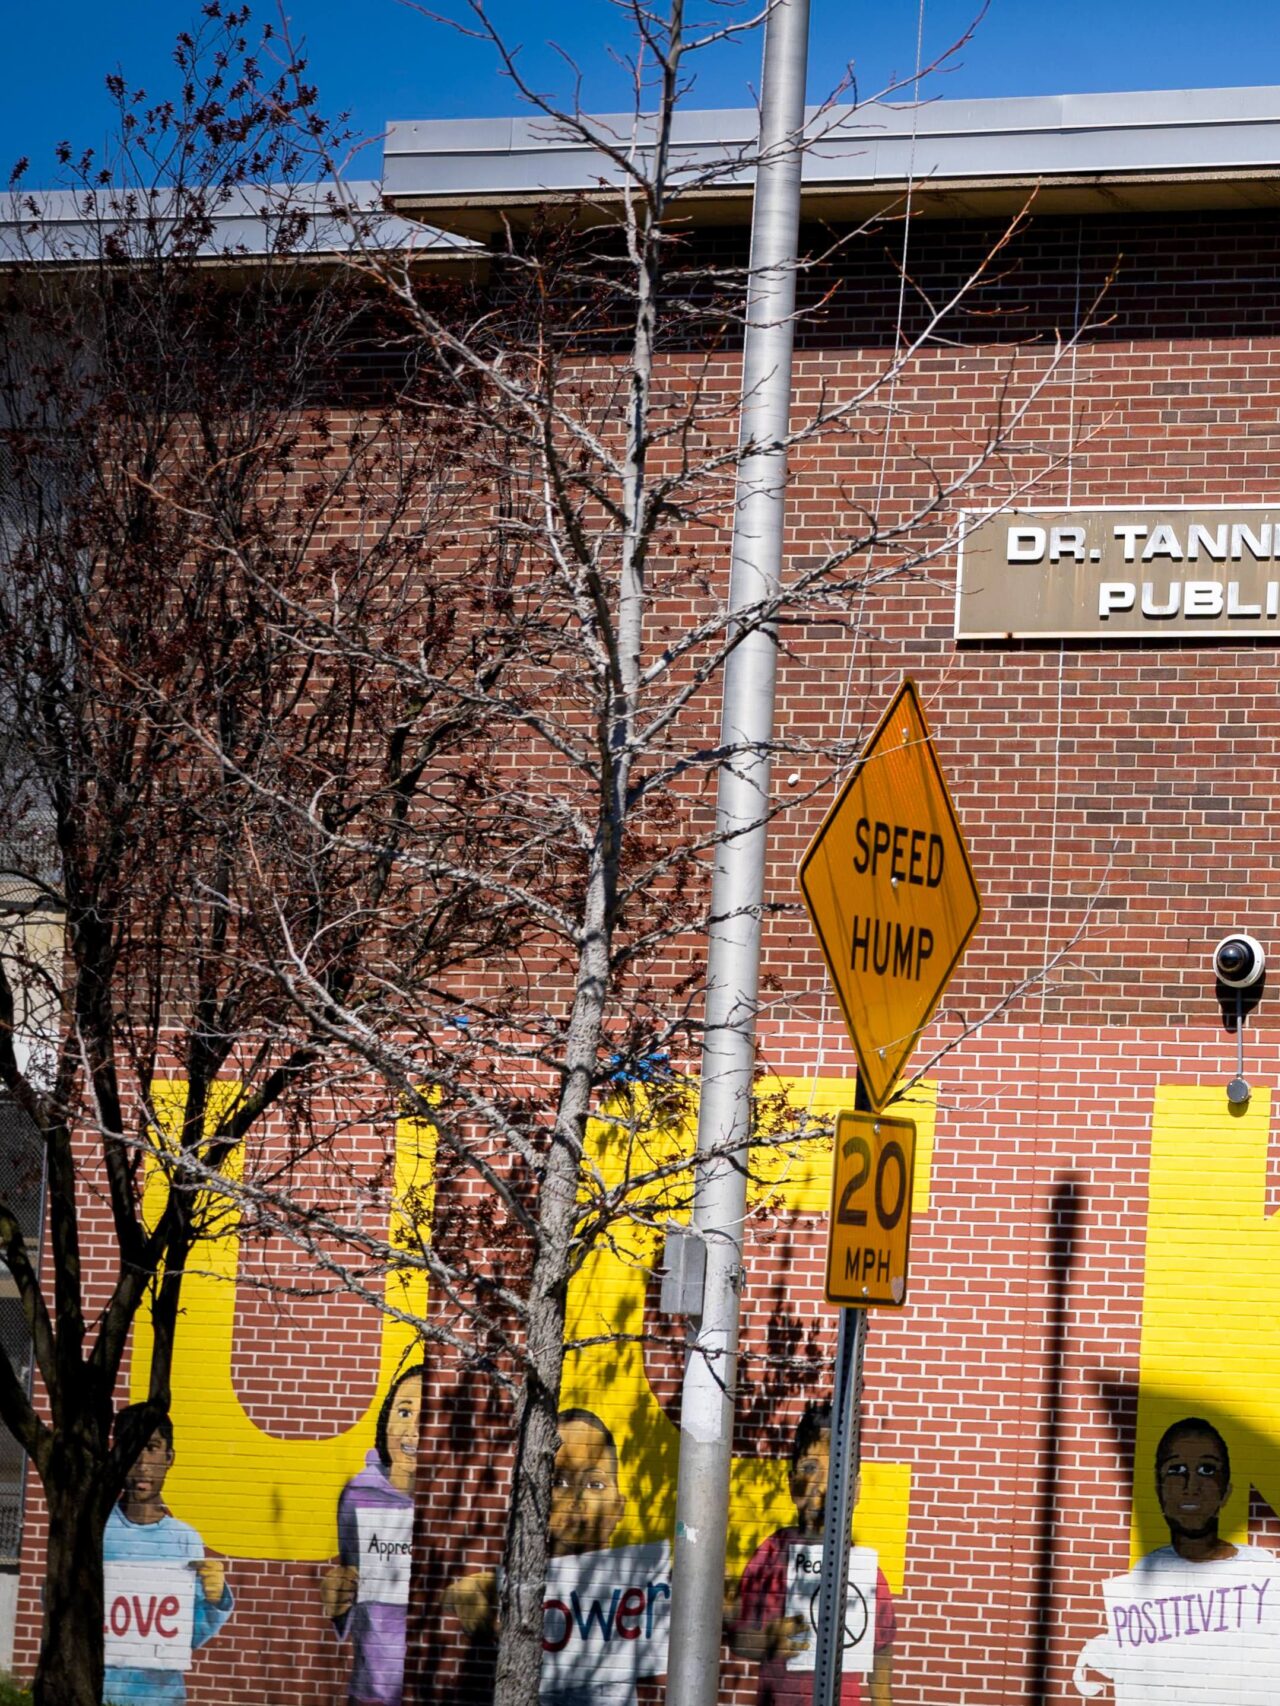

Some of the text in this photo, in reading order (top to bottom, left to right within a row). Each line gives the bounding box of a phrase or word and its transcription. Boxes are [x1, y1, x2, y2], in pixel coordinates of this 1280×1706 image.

[1006, 526, 1101, 562] DR.
[853, 817, 945, 889] SPEED
[850, 915, 935, 982] HUMP
[836, 1136, 907, 1231] 20
[844, 1246, 891, 1284] MPH
[1112, 1578, 1271, 1648] POSITIVITY
